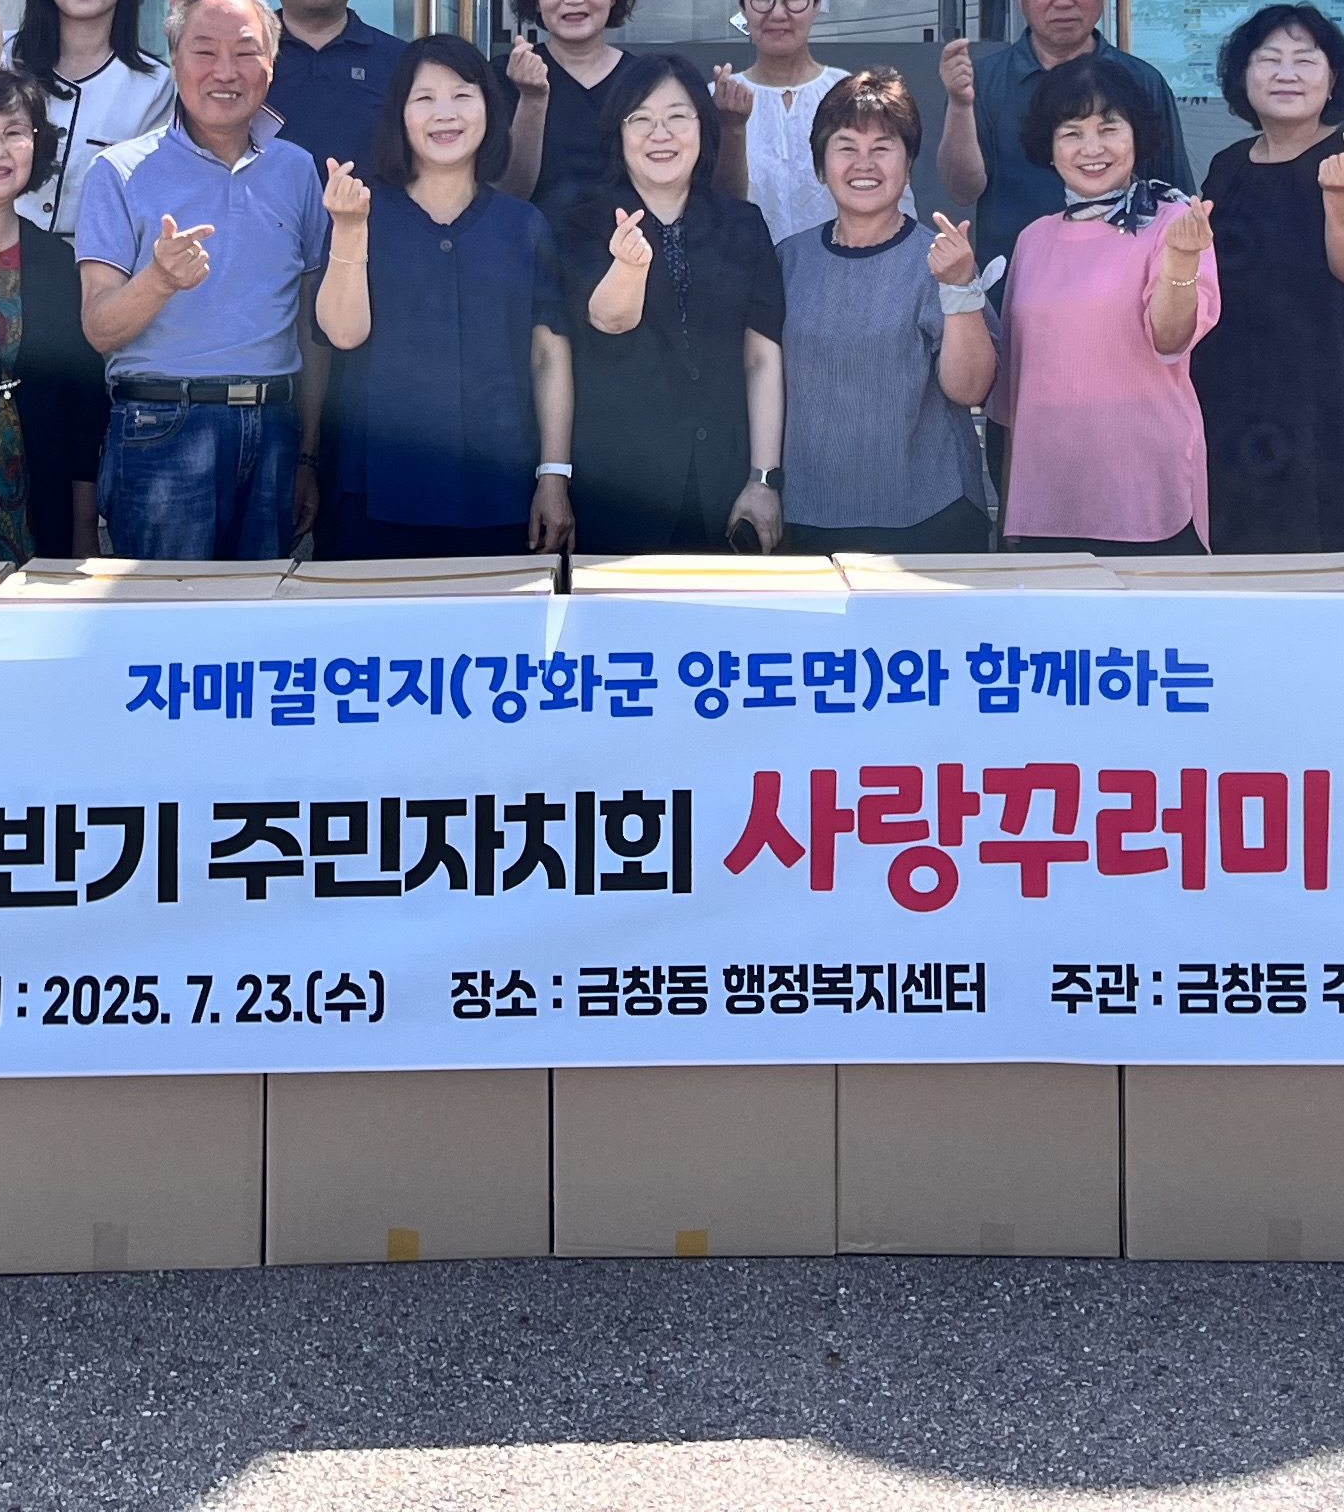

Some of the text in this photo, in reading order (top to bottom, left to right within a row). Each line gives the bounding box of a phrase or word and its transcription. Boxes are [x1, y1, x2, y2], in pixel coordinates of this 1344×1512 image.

[126, 642, 1214, 726] 자매결연지(강화군 양도면)와 함께하는
[208, 790, 693, 900] 주민자치회
[723, 763, 1331, 912] 사랑꾸러미
[42, 975, 170, 1025] 2025.
[186, 975, 220, 1024] 7.
[236, 970, 385, 1024] 23.(수)
[451, 970, 538, 1019] 장소
[578, 965, 708, 1017] 금창동
[722, 963, 986, 1015] 행정복지센터
[1051, 964, 1140, 1015] 주관
[1177, 963, 1307, 1015] 금창동
